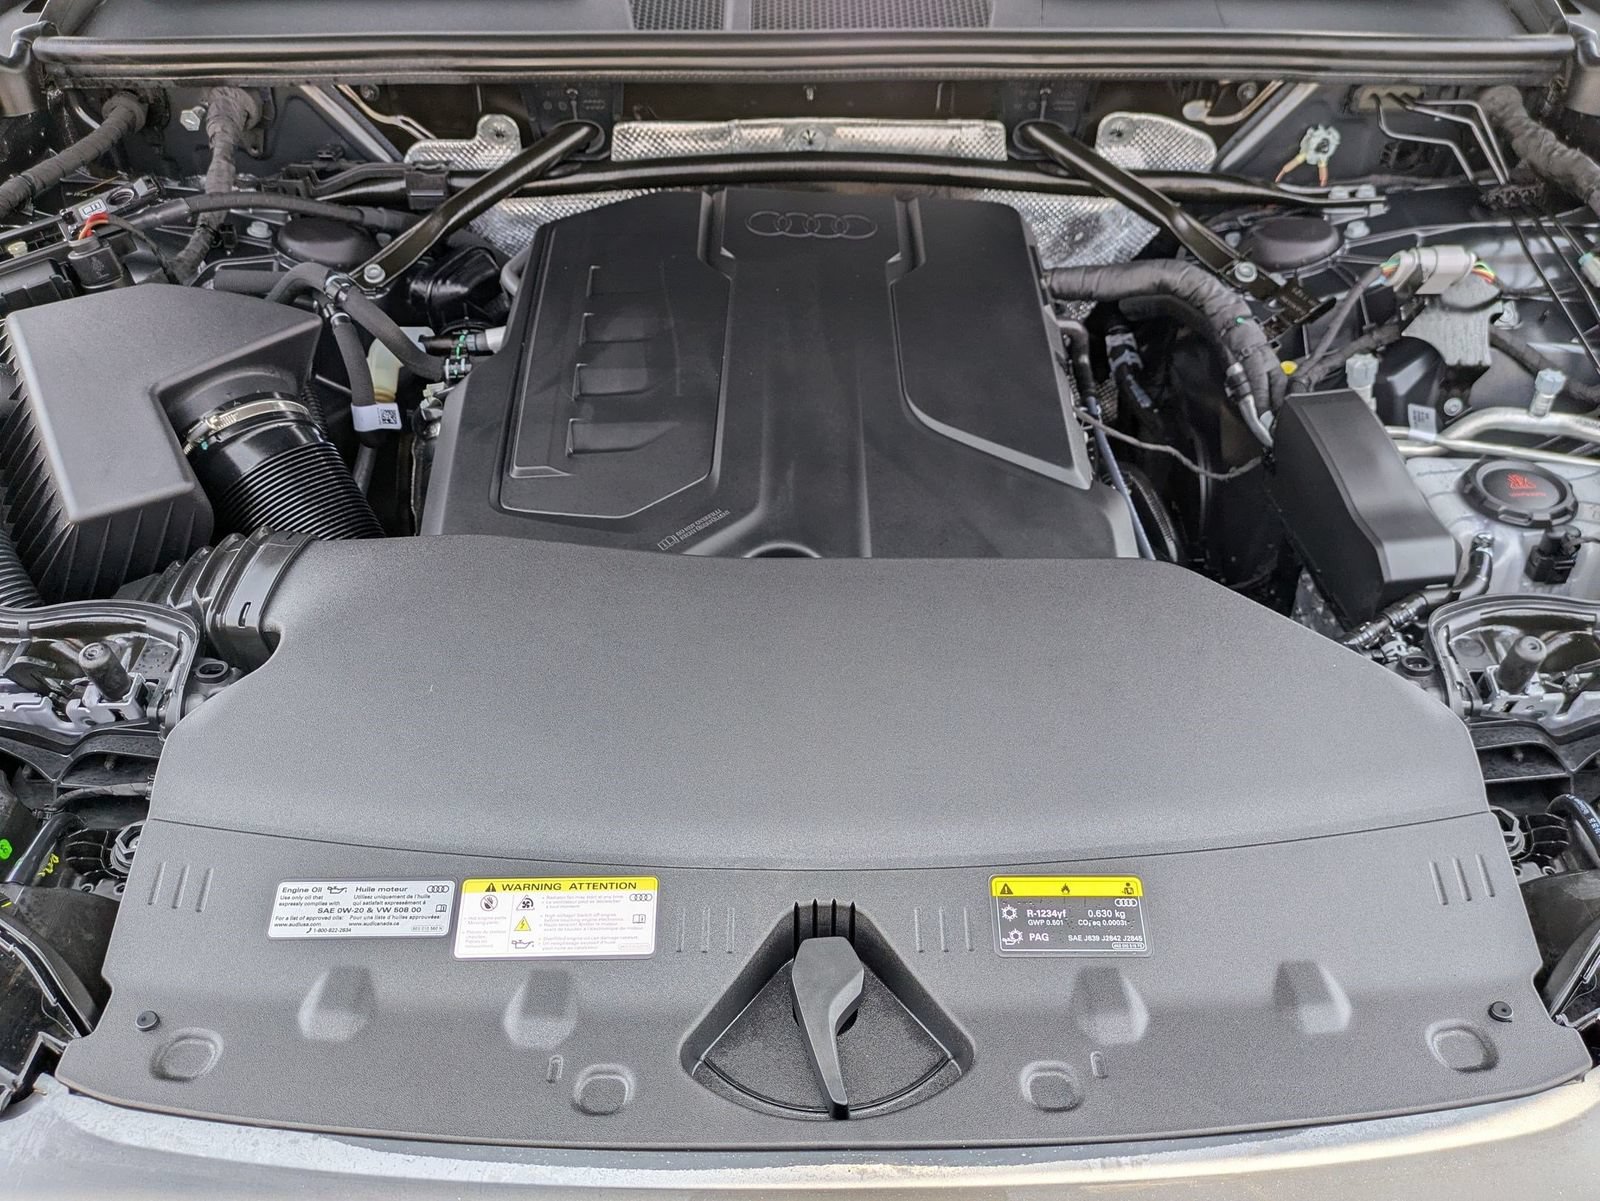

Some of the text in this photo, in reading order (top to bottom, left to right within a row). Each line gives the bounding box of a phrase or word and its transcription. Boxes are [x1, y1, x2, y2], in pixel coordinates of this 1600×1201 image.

[501, 882, 637, 891] WARNING ATTENTION
[1026, 909, 1126, 919] R-1234yf 0.630 kg
[1029, 932, 1050, 941] PAG
